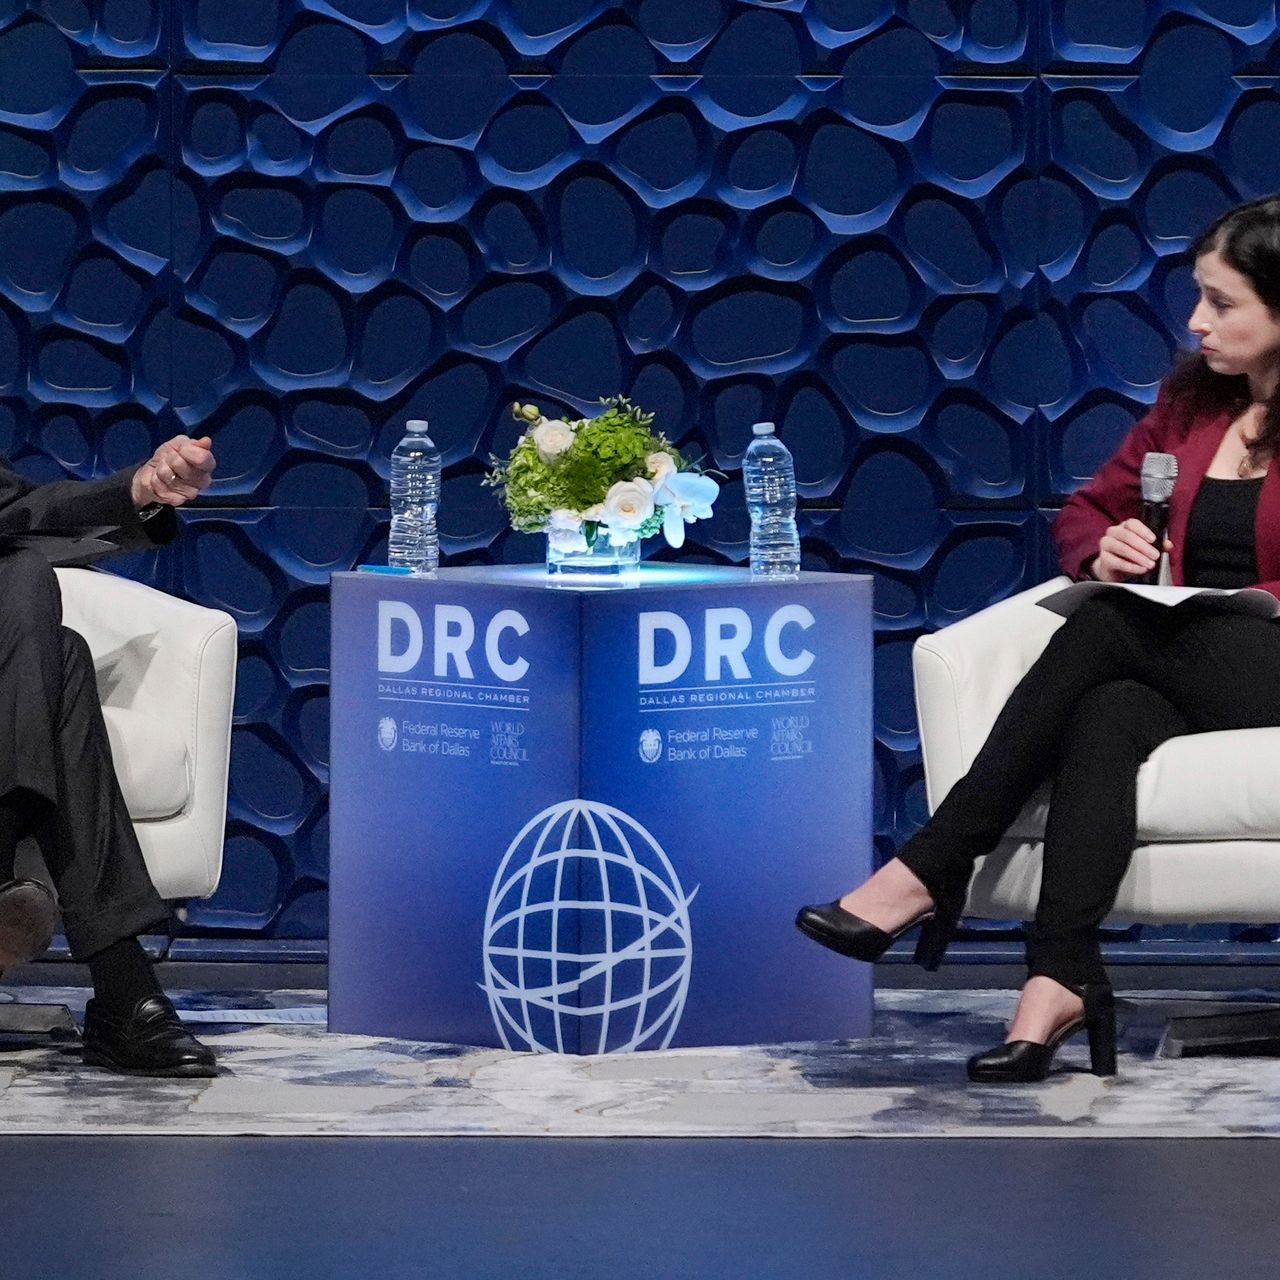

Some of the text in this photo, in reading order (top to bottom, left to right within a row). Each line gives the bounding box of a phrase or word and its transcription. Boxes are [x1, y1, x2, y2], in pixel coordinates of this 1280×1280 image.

[377, 600, 531, 682] DRC
[638, 604, 816, 685] DRC
[378, 684, 530, 704] DALLAS REGIONAL CHAMBER
[639, 687, 816, 706] DALLAS REGIONAL CHAMBER
[402, 720, 481, 740] Federal Reserve
[668, 726, 759, 744] Federal Reserve
[402, 738, 470, 757] Bank of Dallas
[667, 744, 748, 762] Bank of Dallas
